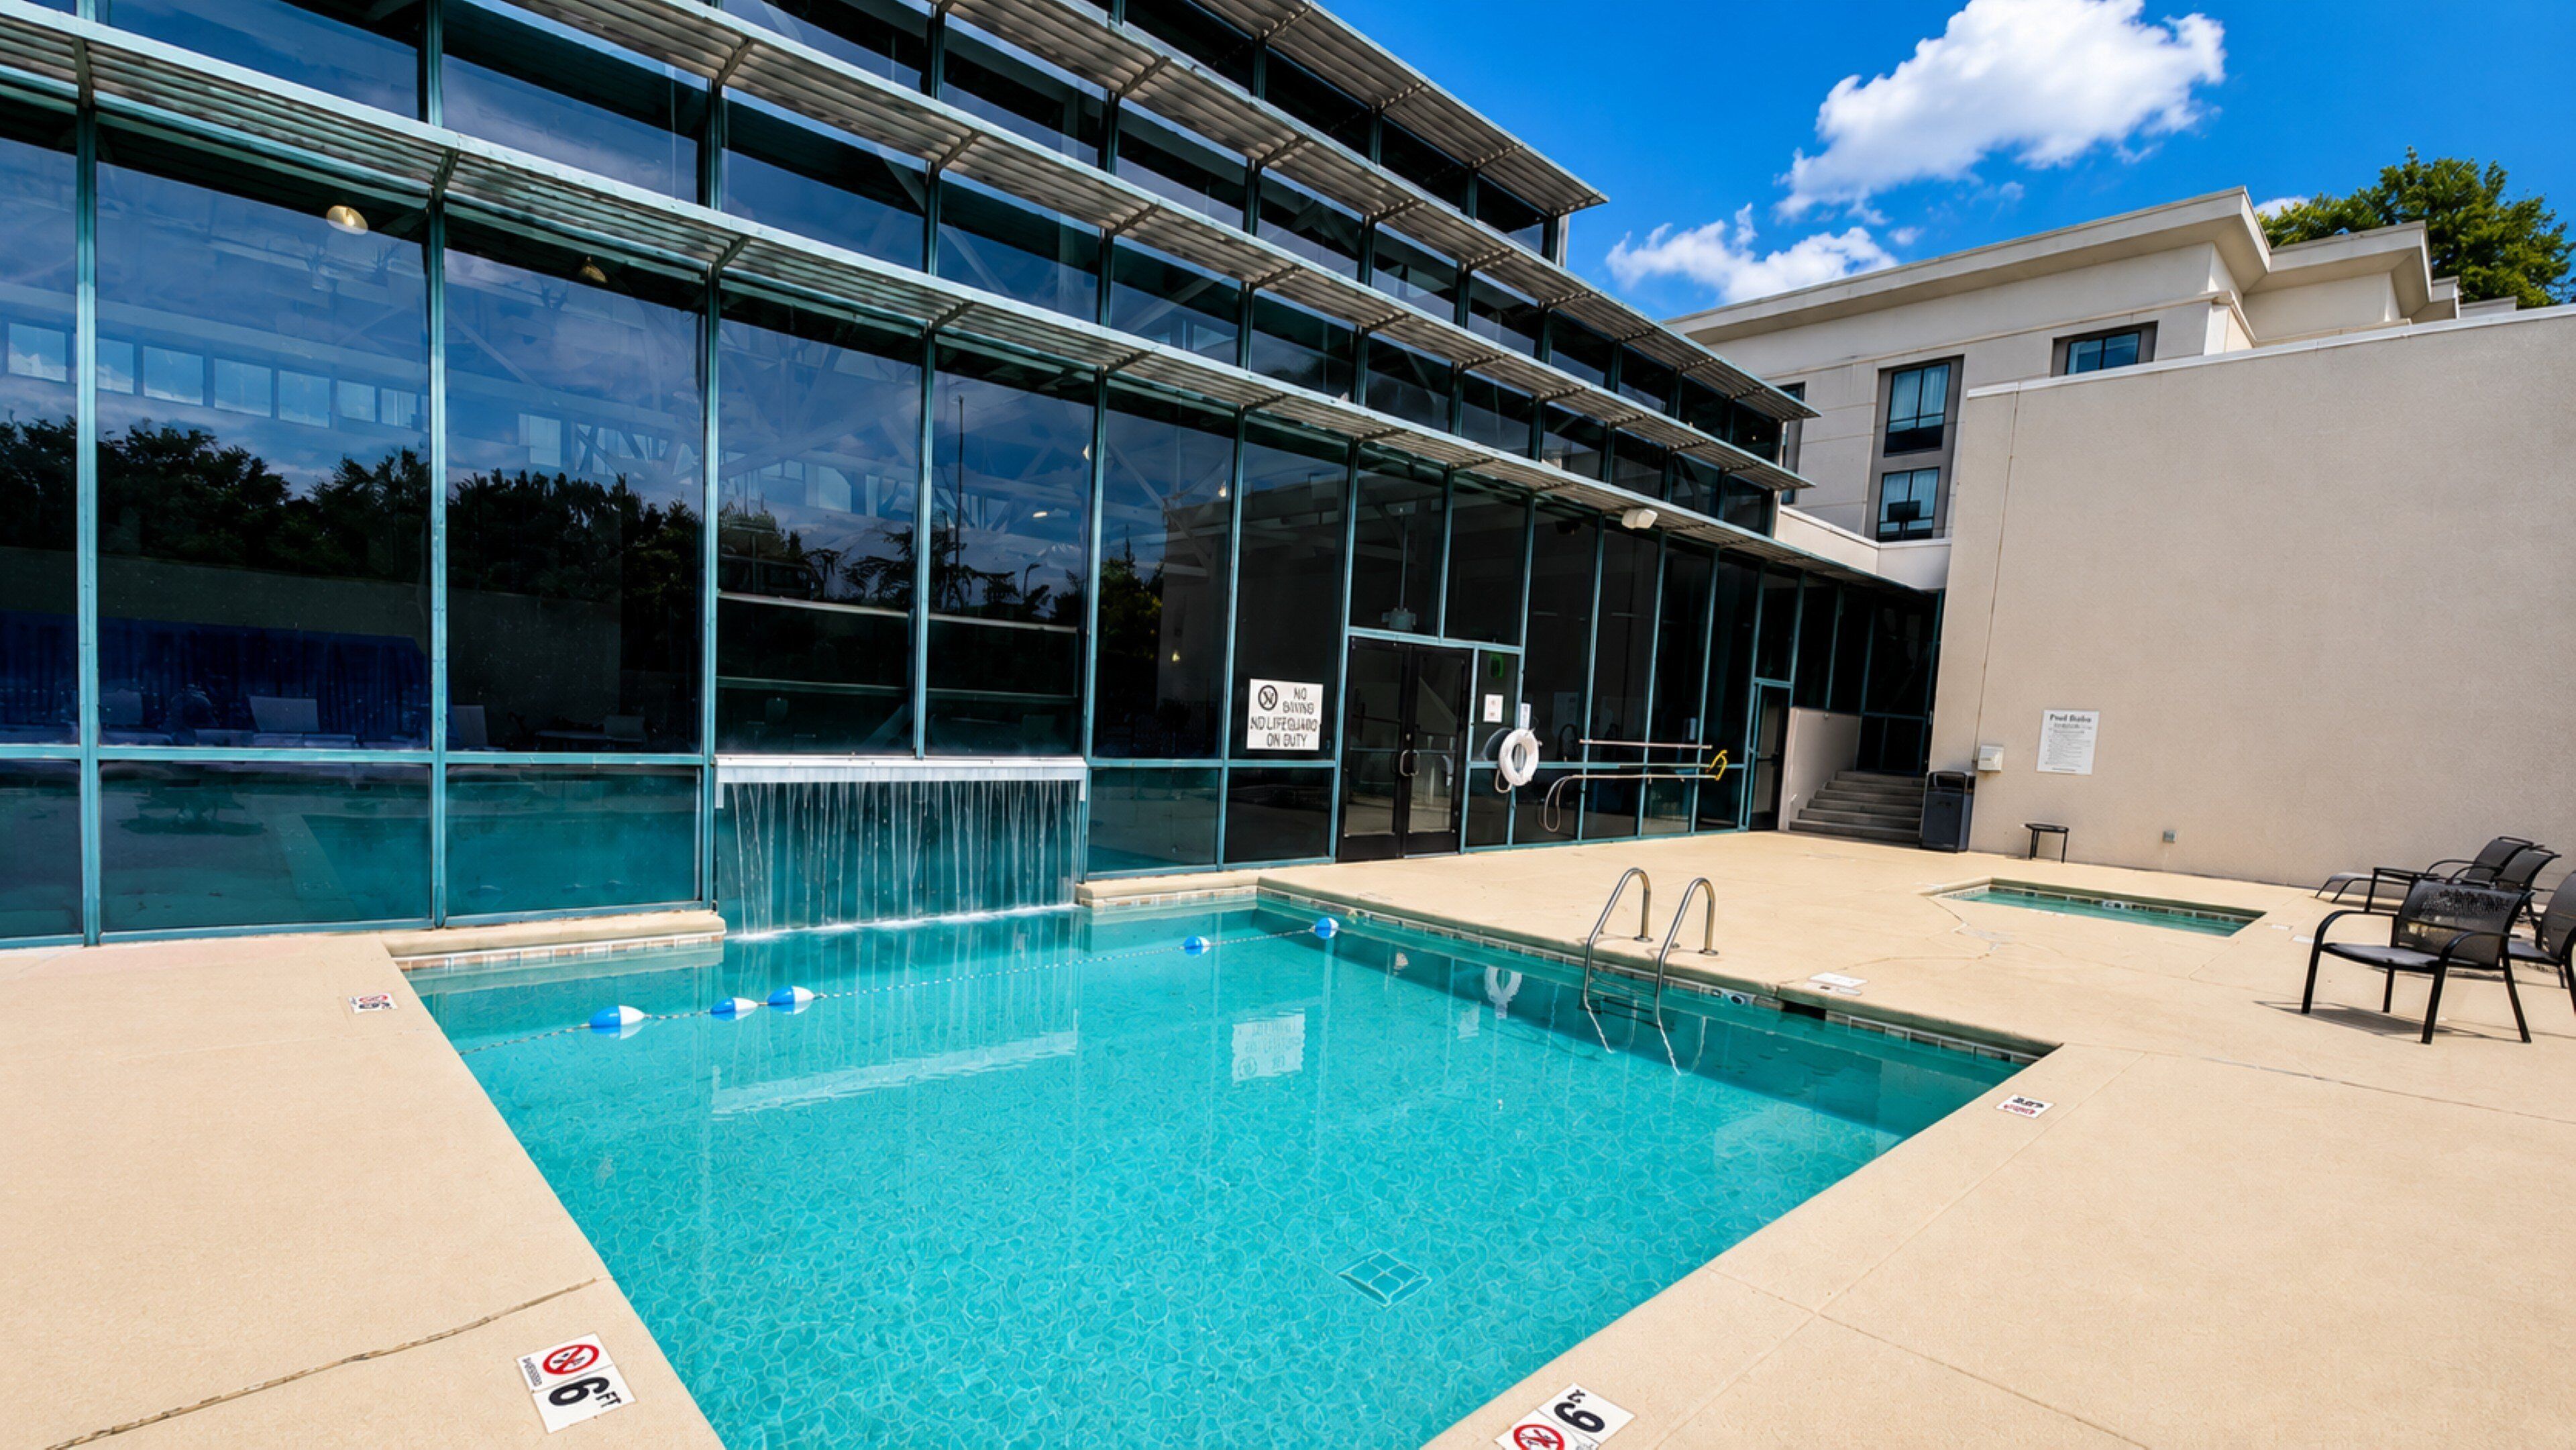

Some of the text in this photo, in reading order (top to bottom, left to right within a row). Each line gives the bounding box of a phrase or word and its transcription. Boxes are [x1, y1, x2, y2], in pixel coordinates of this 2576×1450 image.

[1293, 687, 1307, 700] NO
[1267, 733, 1281, 747] ON
[548, 1377, 610, 1406] 6
